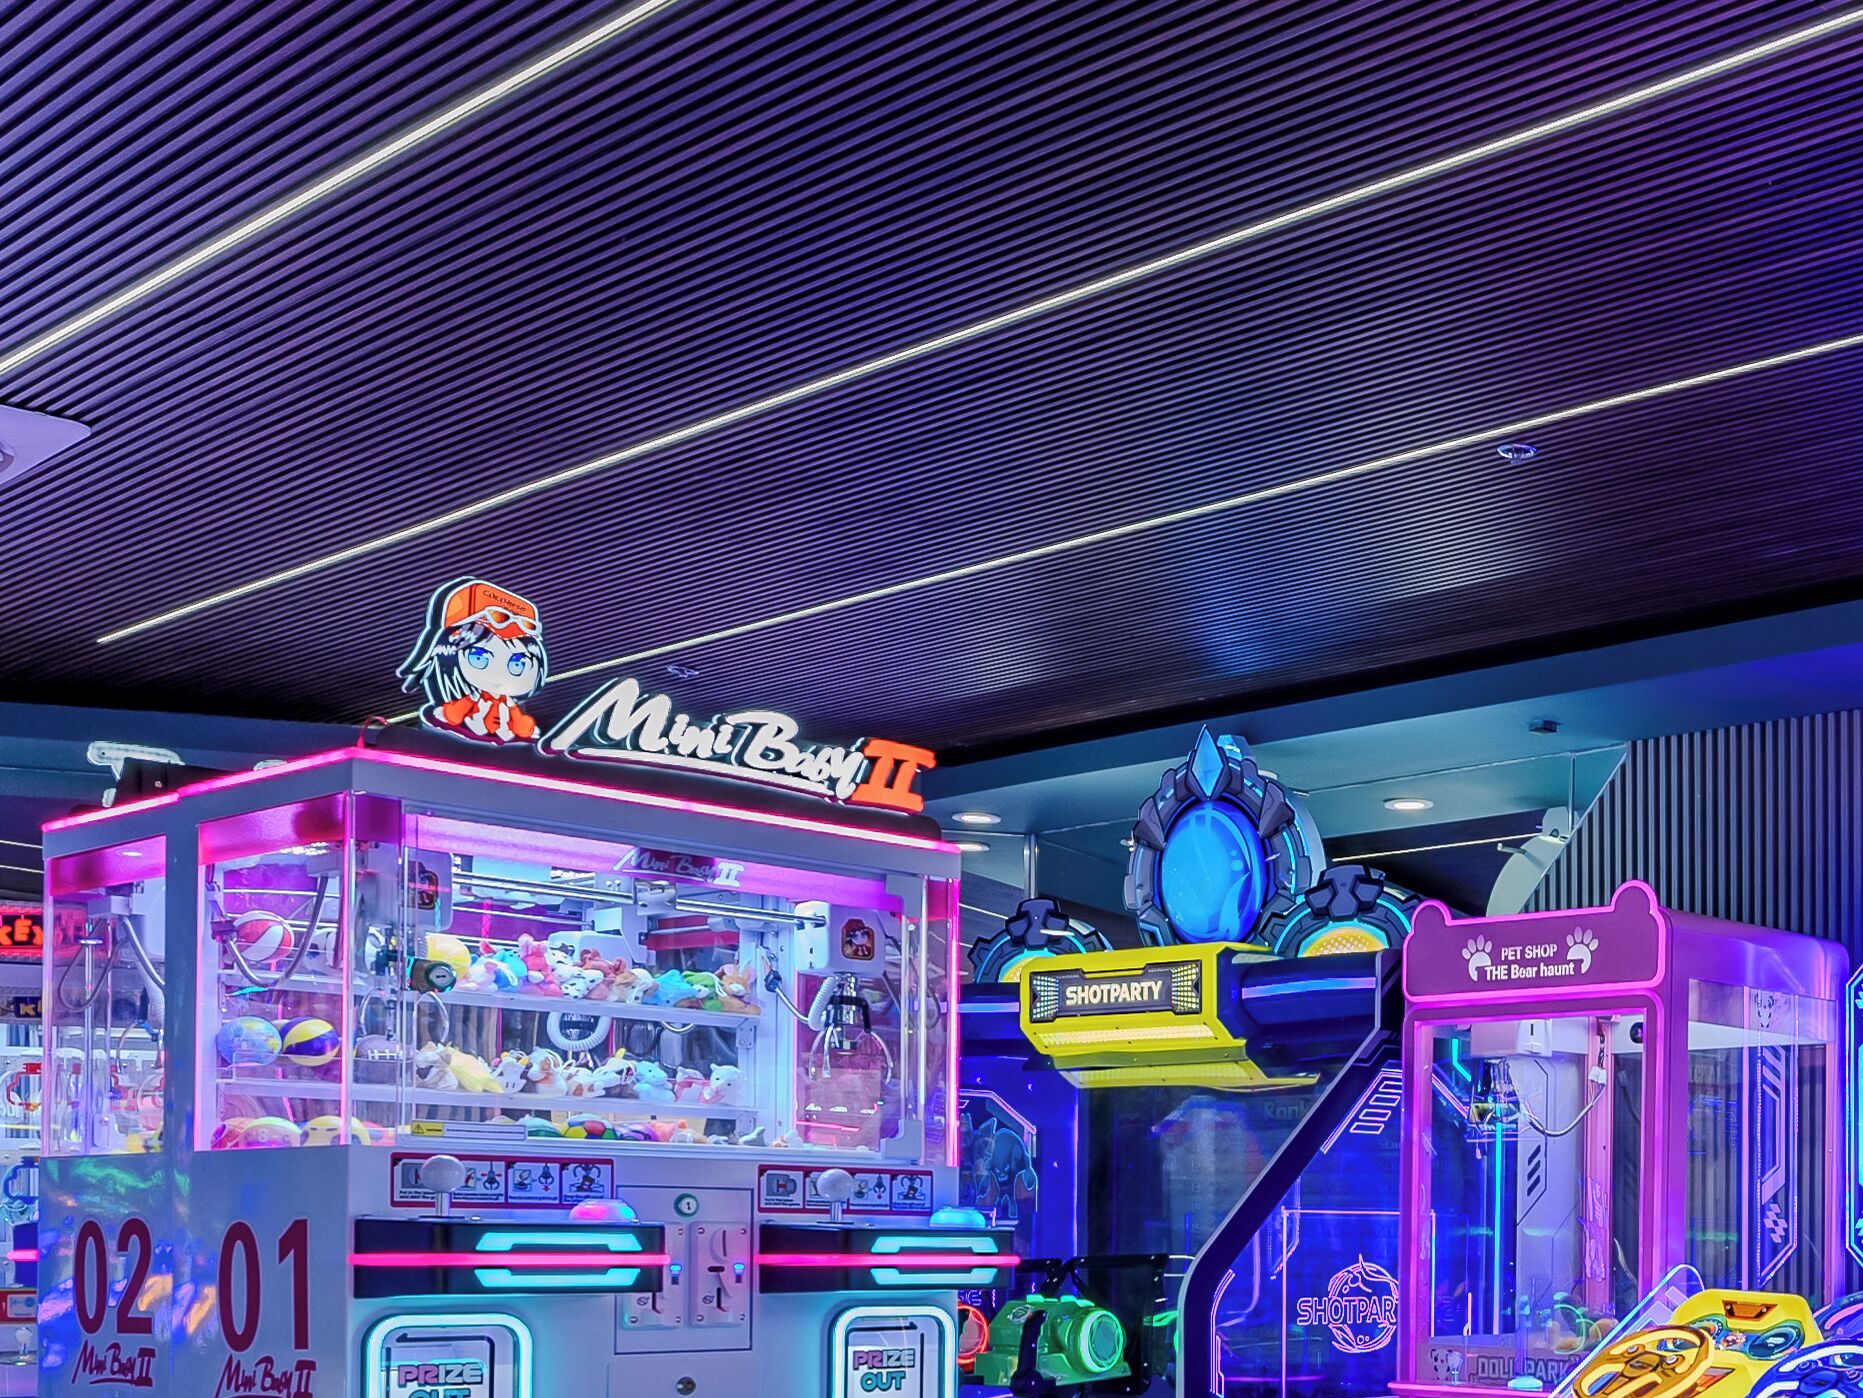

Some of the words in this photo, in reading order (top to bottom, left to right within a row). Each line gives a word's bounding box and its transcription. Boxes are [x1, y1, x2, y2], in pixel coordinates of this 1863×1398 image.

[551, 678, 733, 758] Mini
[1501, 947, 1521, 960] PET
[1524, 943, 1558, 959] SHOP
[1484, 965, 1508, 981] THE
[1539, 961, 1575, 977] haunt
[1065, 980, 1164, 1007] SHOTPARTY
[74, 1217, 153, 1334] 02
[218, 1218, 310, 1352] 01
[853, 1349, 916, 1371] PRIZE
[398, 1362, 485, 1388] PRIZE
[859, 1370, 907, 1393] OUT
